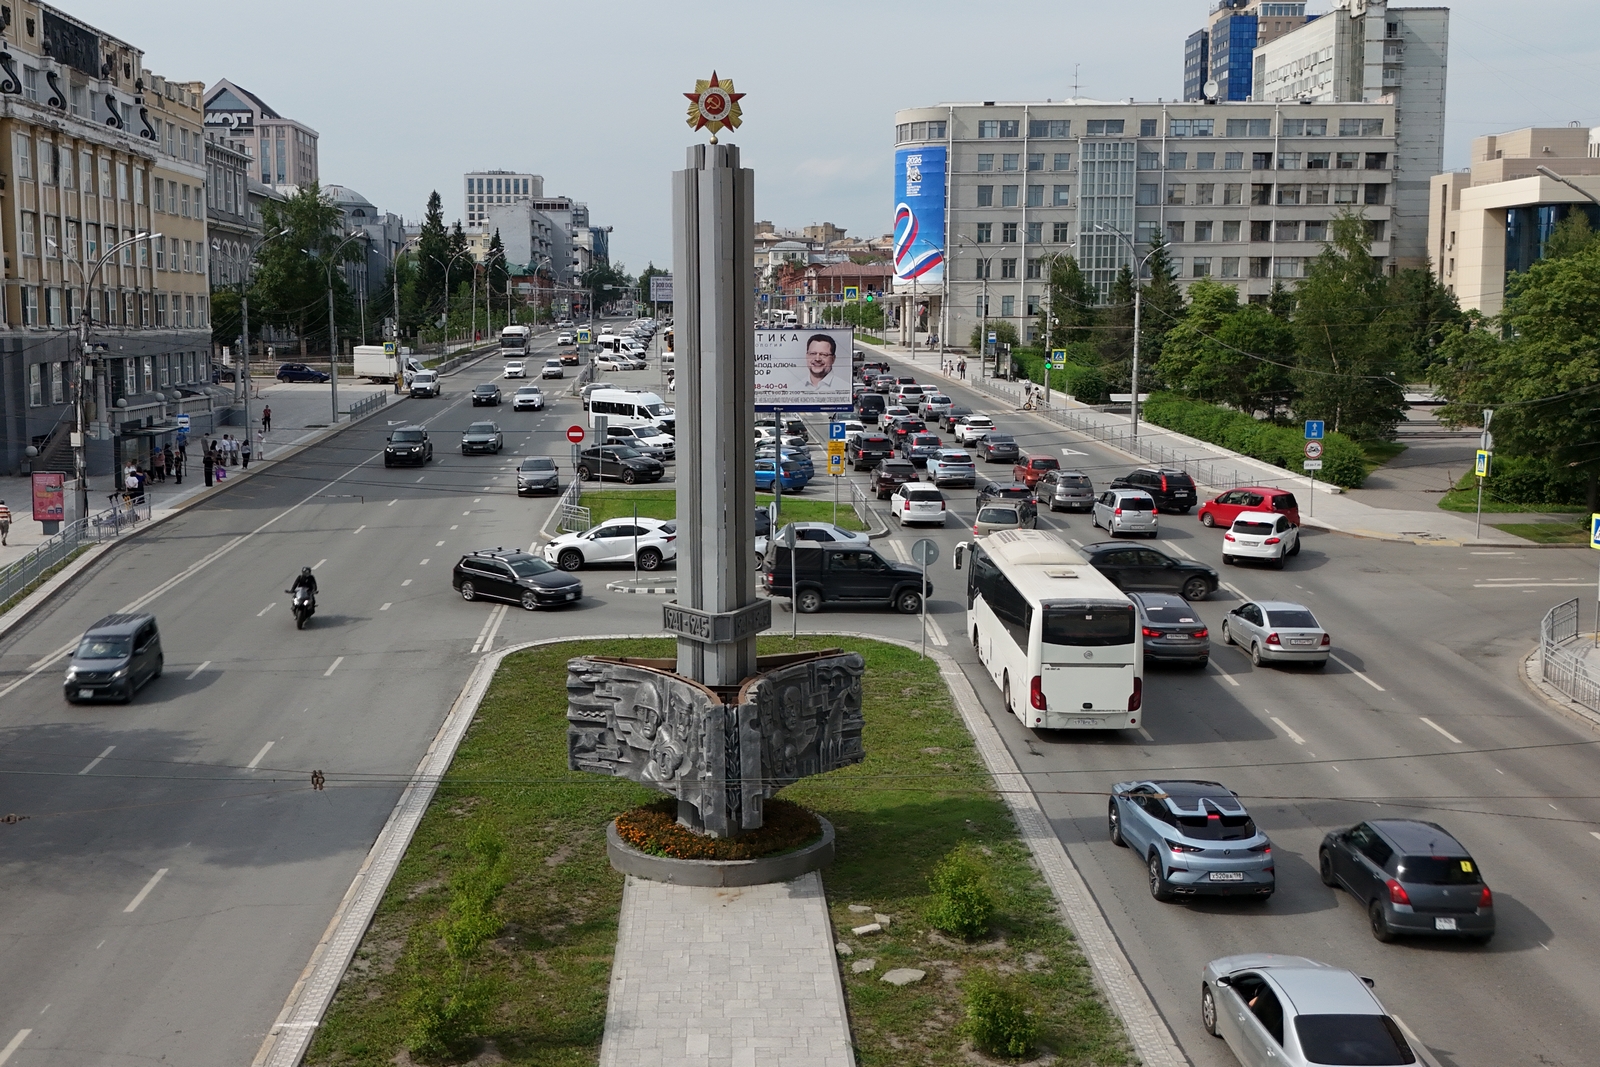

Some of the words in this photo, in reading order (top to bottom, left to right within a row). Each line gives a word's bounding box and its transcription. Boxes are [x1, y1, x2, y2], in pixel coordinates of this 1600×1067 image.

[756, 333, 799, 342] ТИКА
[832, 424, 842, 437] P
[833, 456, 839, 464] P
